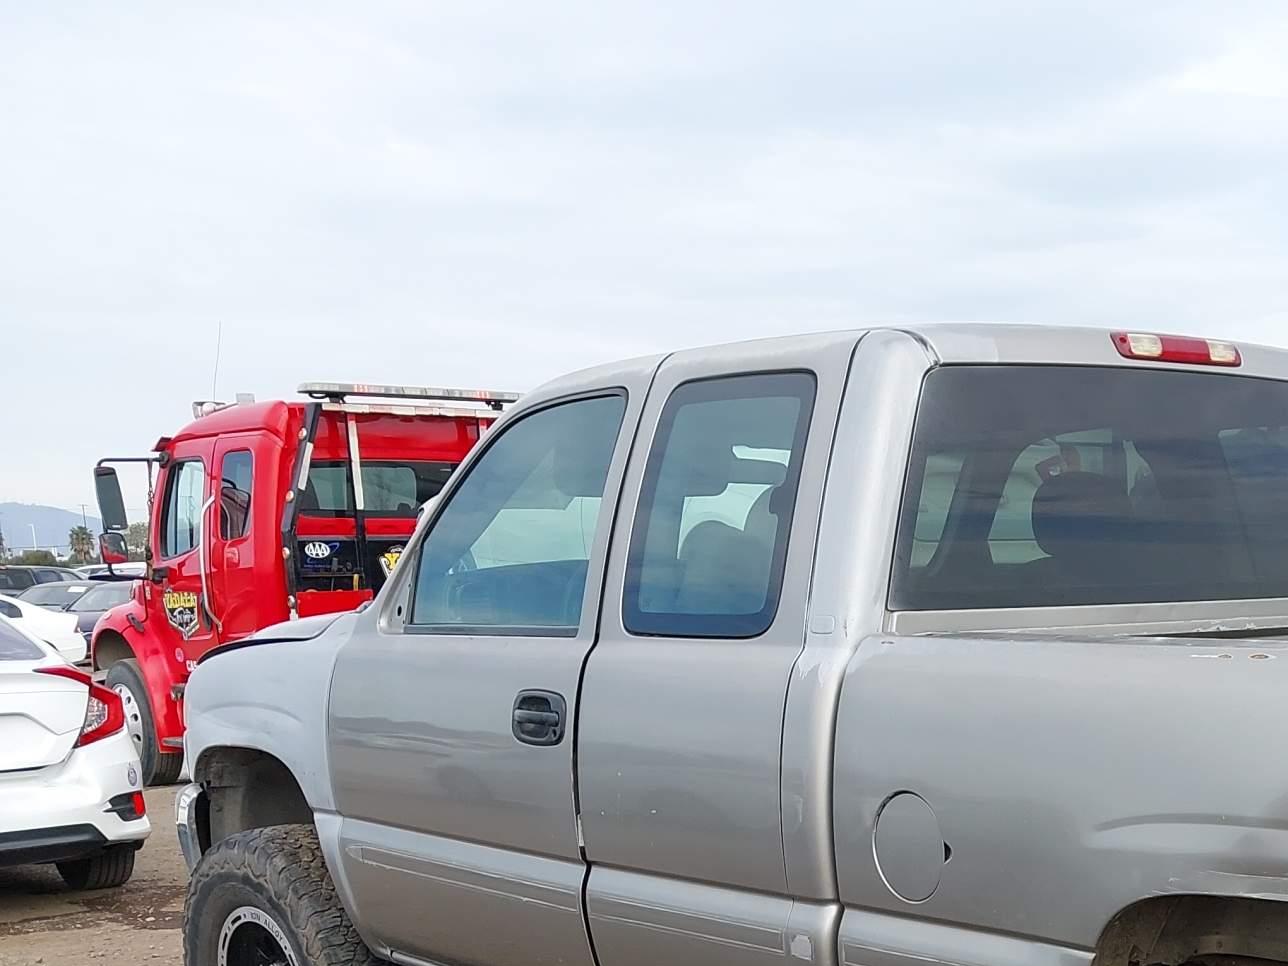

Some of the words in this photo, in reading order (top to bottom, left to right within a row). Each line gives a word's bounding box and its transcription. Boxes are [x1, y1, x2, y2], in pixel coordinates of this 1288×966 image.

[307, 542, 329, 557] AAA
[250, 911, 261, 922] ION
[263, 919, 283, 942] ALLOY
